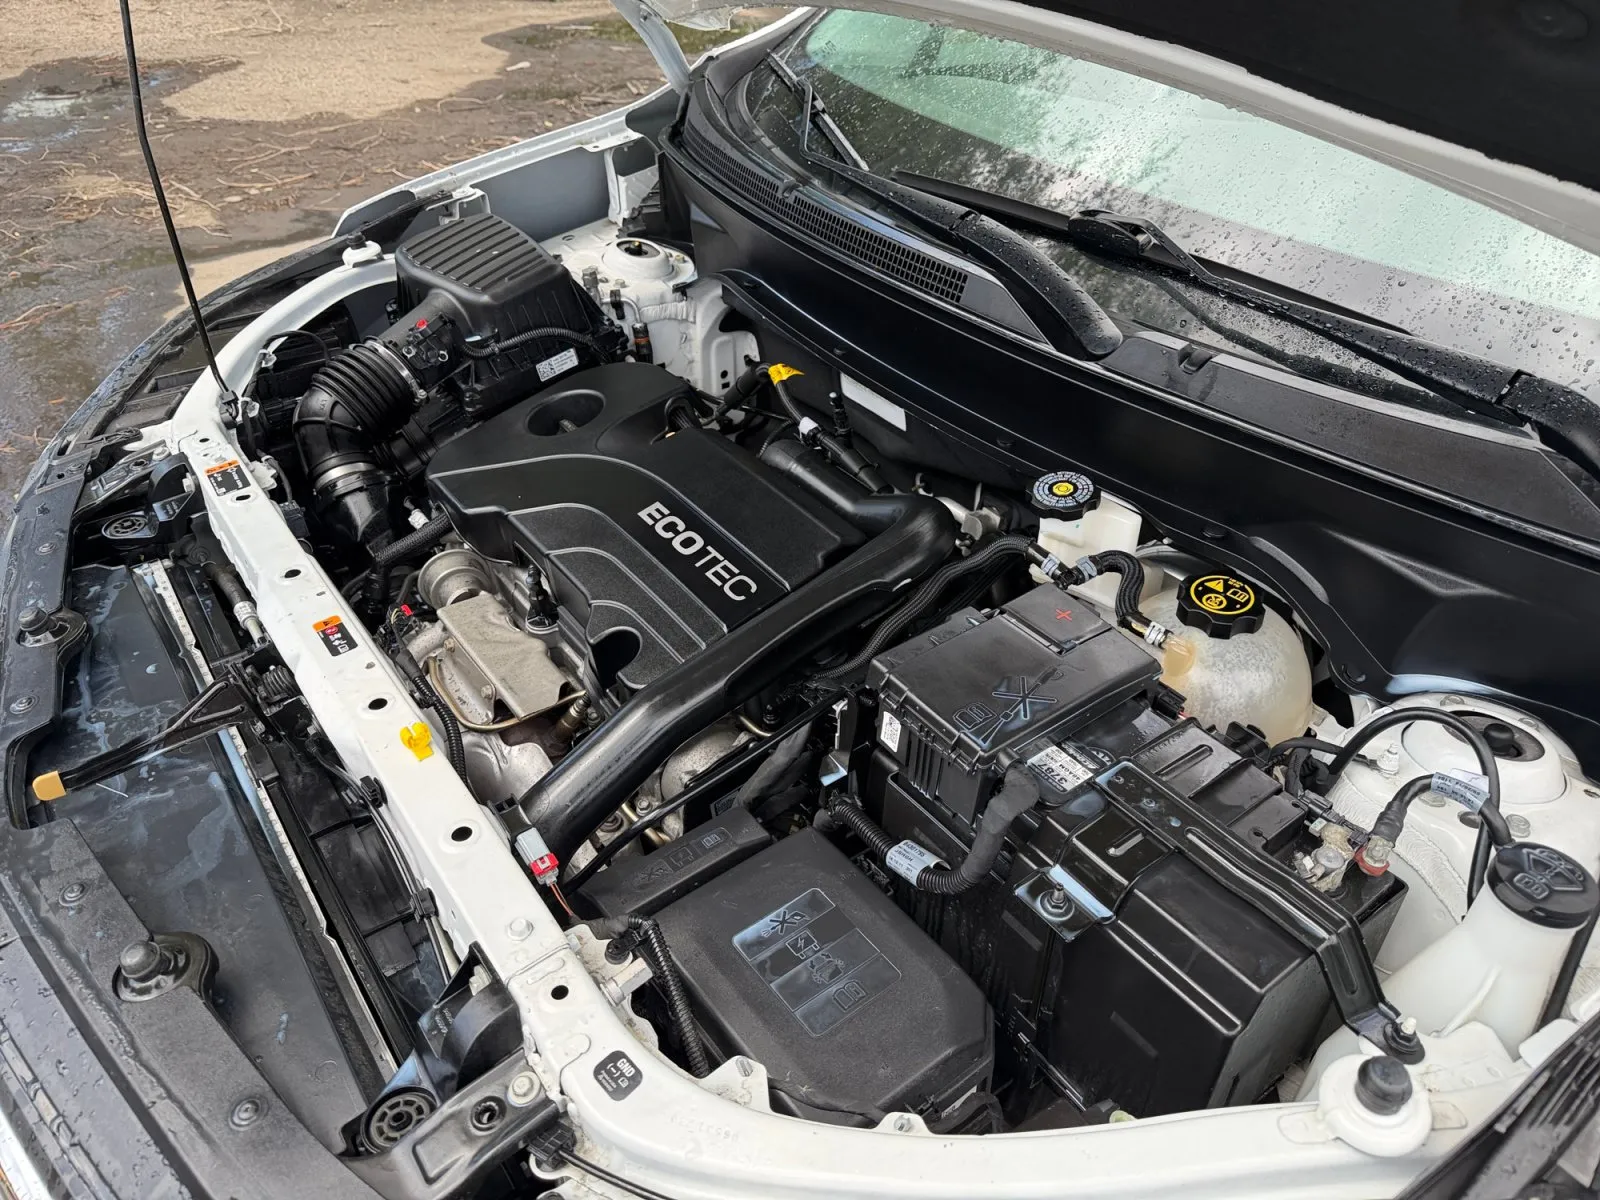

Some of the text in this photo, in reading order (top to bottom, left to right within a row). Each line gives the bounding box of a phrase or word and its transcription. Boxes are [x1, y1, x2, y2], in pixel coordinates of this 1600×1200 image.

[637, 501, 757, 601] ECOTEC
[1037, 763, 1068, 785] 3787
[616, 1058, 636, 1077] GND
